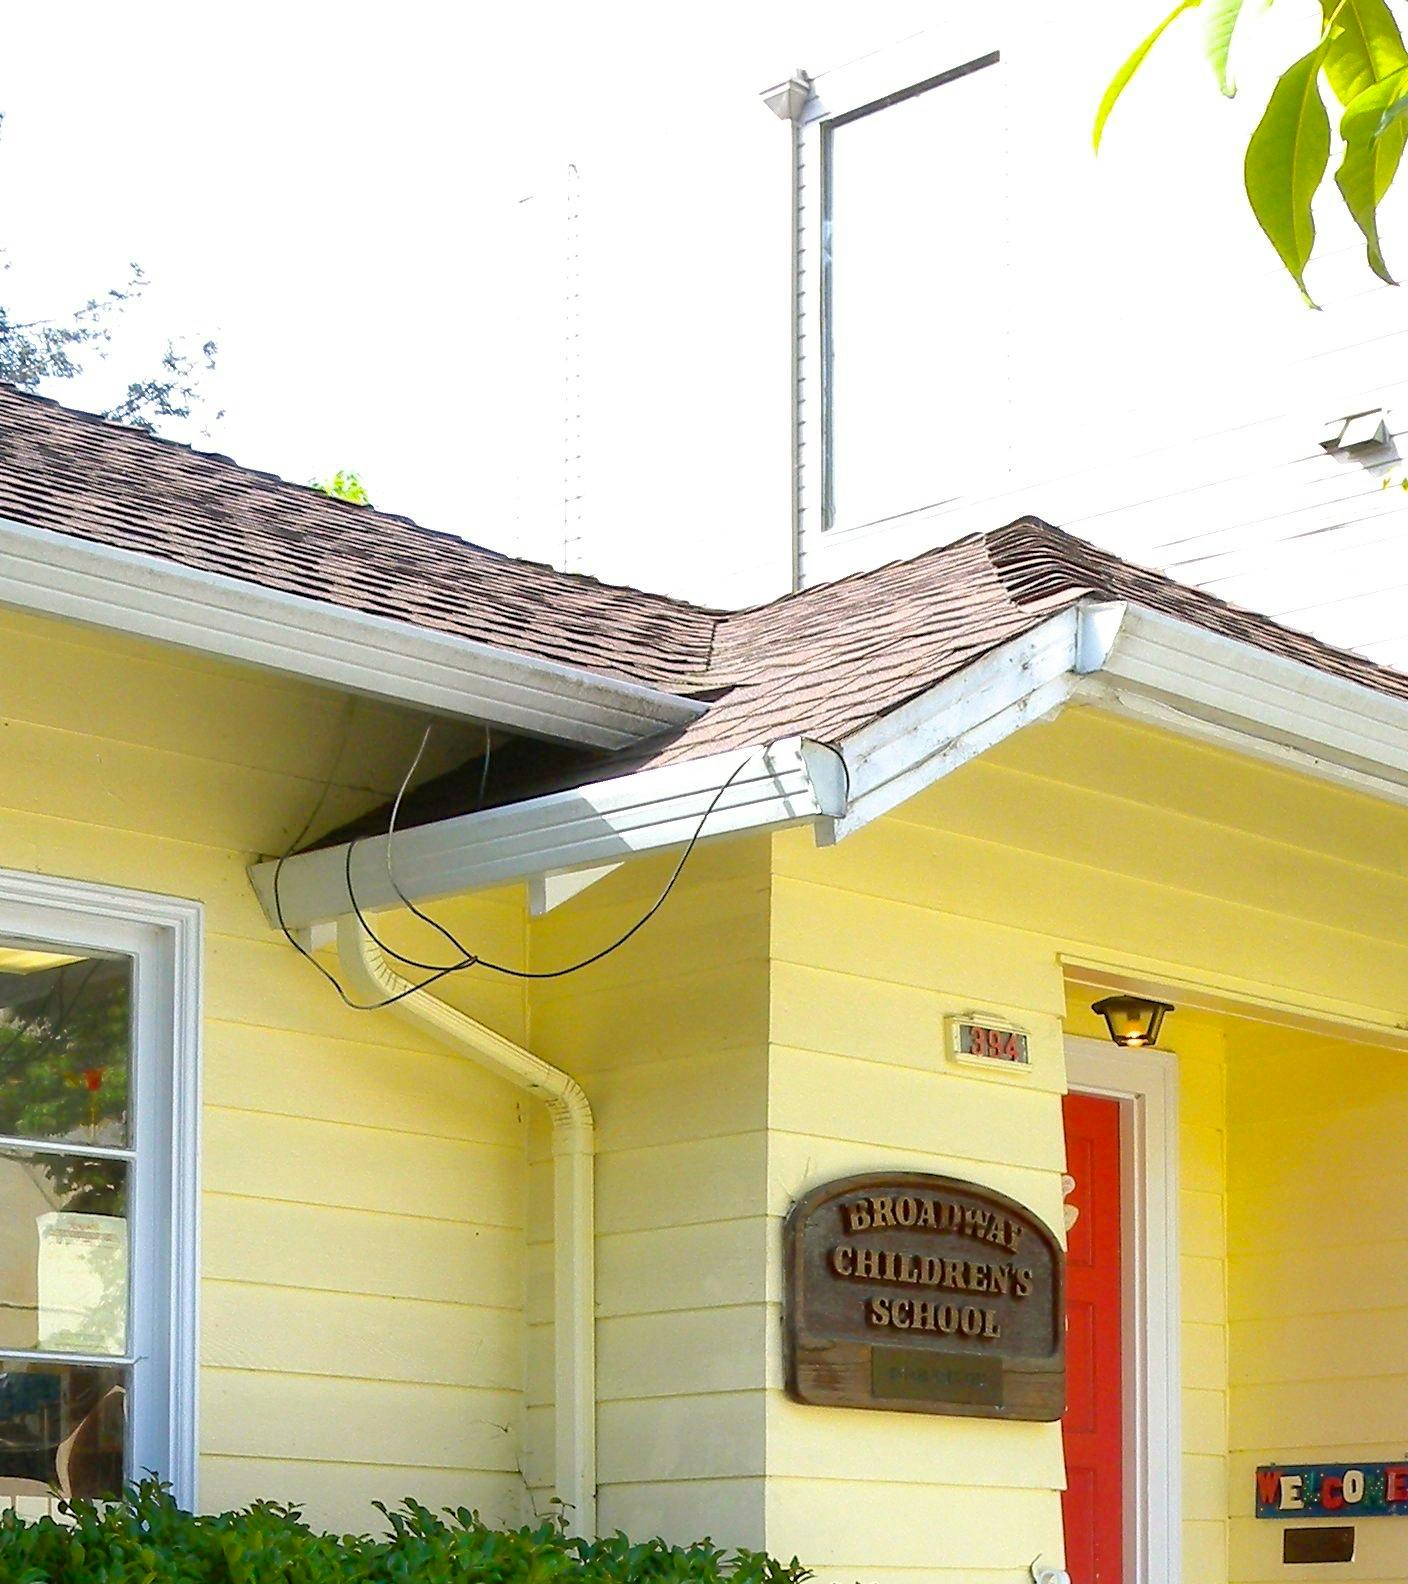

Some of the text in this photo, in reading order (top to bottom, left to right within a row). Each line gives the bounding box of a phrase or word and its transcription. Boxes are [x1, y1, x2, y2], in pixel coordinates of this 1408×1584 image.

[849, 1196, 1024, 1254] BROADWAY
[831, 1245, 1034, 1297] CHILDREN'S
[870, 1298, 1001, 1338] SCHOOL
